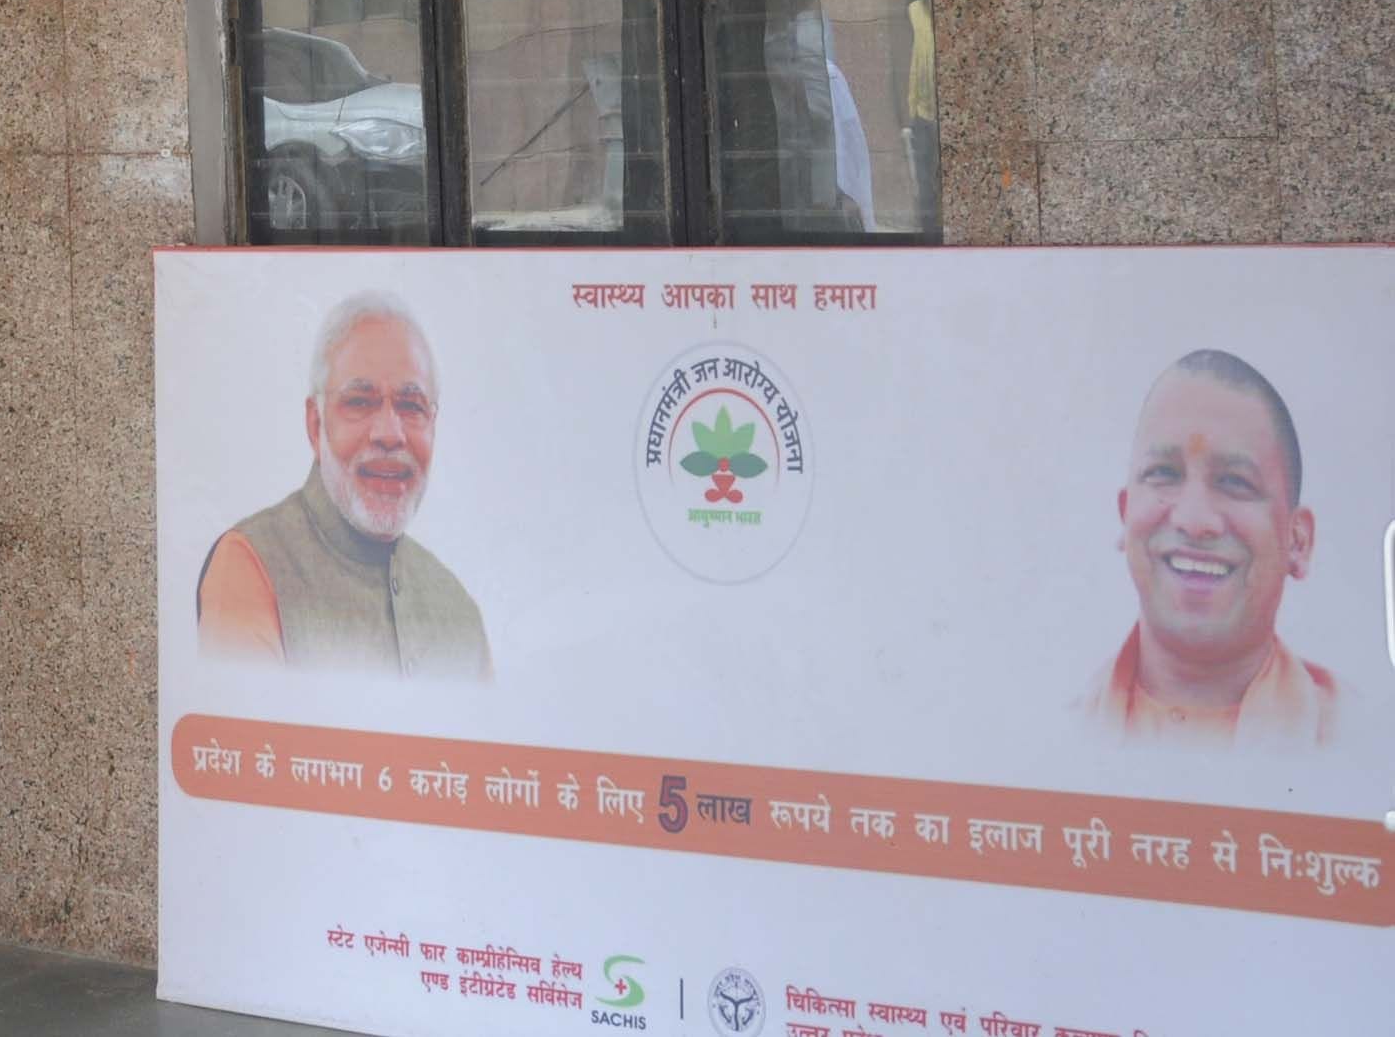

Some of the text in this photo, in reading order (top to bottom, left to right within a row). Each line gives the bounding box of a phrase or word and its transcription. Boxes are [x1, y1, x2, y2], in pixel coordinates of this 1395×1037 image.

[572, 284, 877, 311] स्वास्थ्य आपका साथ हमारा
[646, 357, 803, 474] प्रधानमंत्री जन आरोग्य योजना
[191, 737, 241, 777] प्रदेश
[255, 742, 276, 778] के
[290, 755, 363, 790] लगभग
[377, 771, 393, 793] 6
[409, 760, 469, 809] करोड़
[485, 768, 541, 807] लोगों
[557, 773, 579, 811] के
[595, 776, 645, 823] लिए
[657, 774, 689, 834] 5
[696, 791, 752, 826] लाख
[850, 806, 895, 840] तक
[915, 812, 950, 846] का
[967, 816, 1044, 854] इलाज
[1063, 817, 1111, 868] पूरी
[1130, 832, 1191, 870] तरह
[1212, 830, 1238, 874] से
[327, 925, 355, 949] स्टेट
[364, 931, 410, 958] एजेन्सी
[420, 942, 447, 962] फार
[552, 954, 583, 981] हेल्थ
[421, 970, 583, 1010] एण्ड इंटीग्रेटेड सर्विसेज
[785, 983, 856, 1019] चिकित्सा
[868, 1001, 928, 1028] स्वास्थ्य
[940, 1007, 966, 1035] एवं
[591, 1009, 647, 1031] SACHIS
